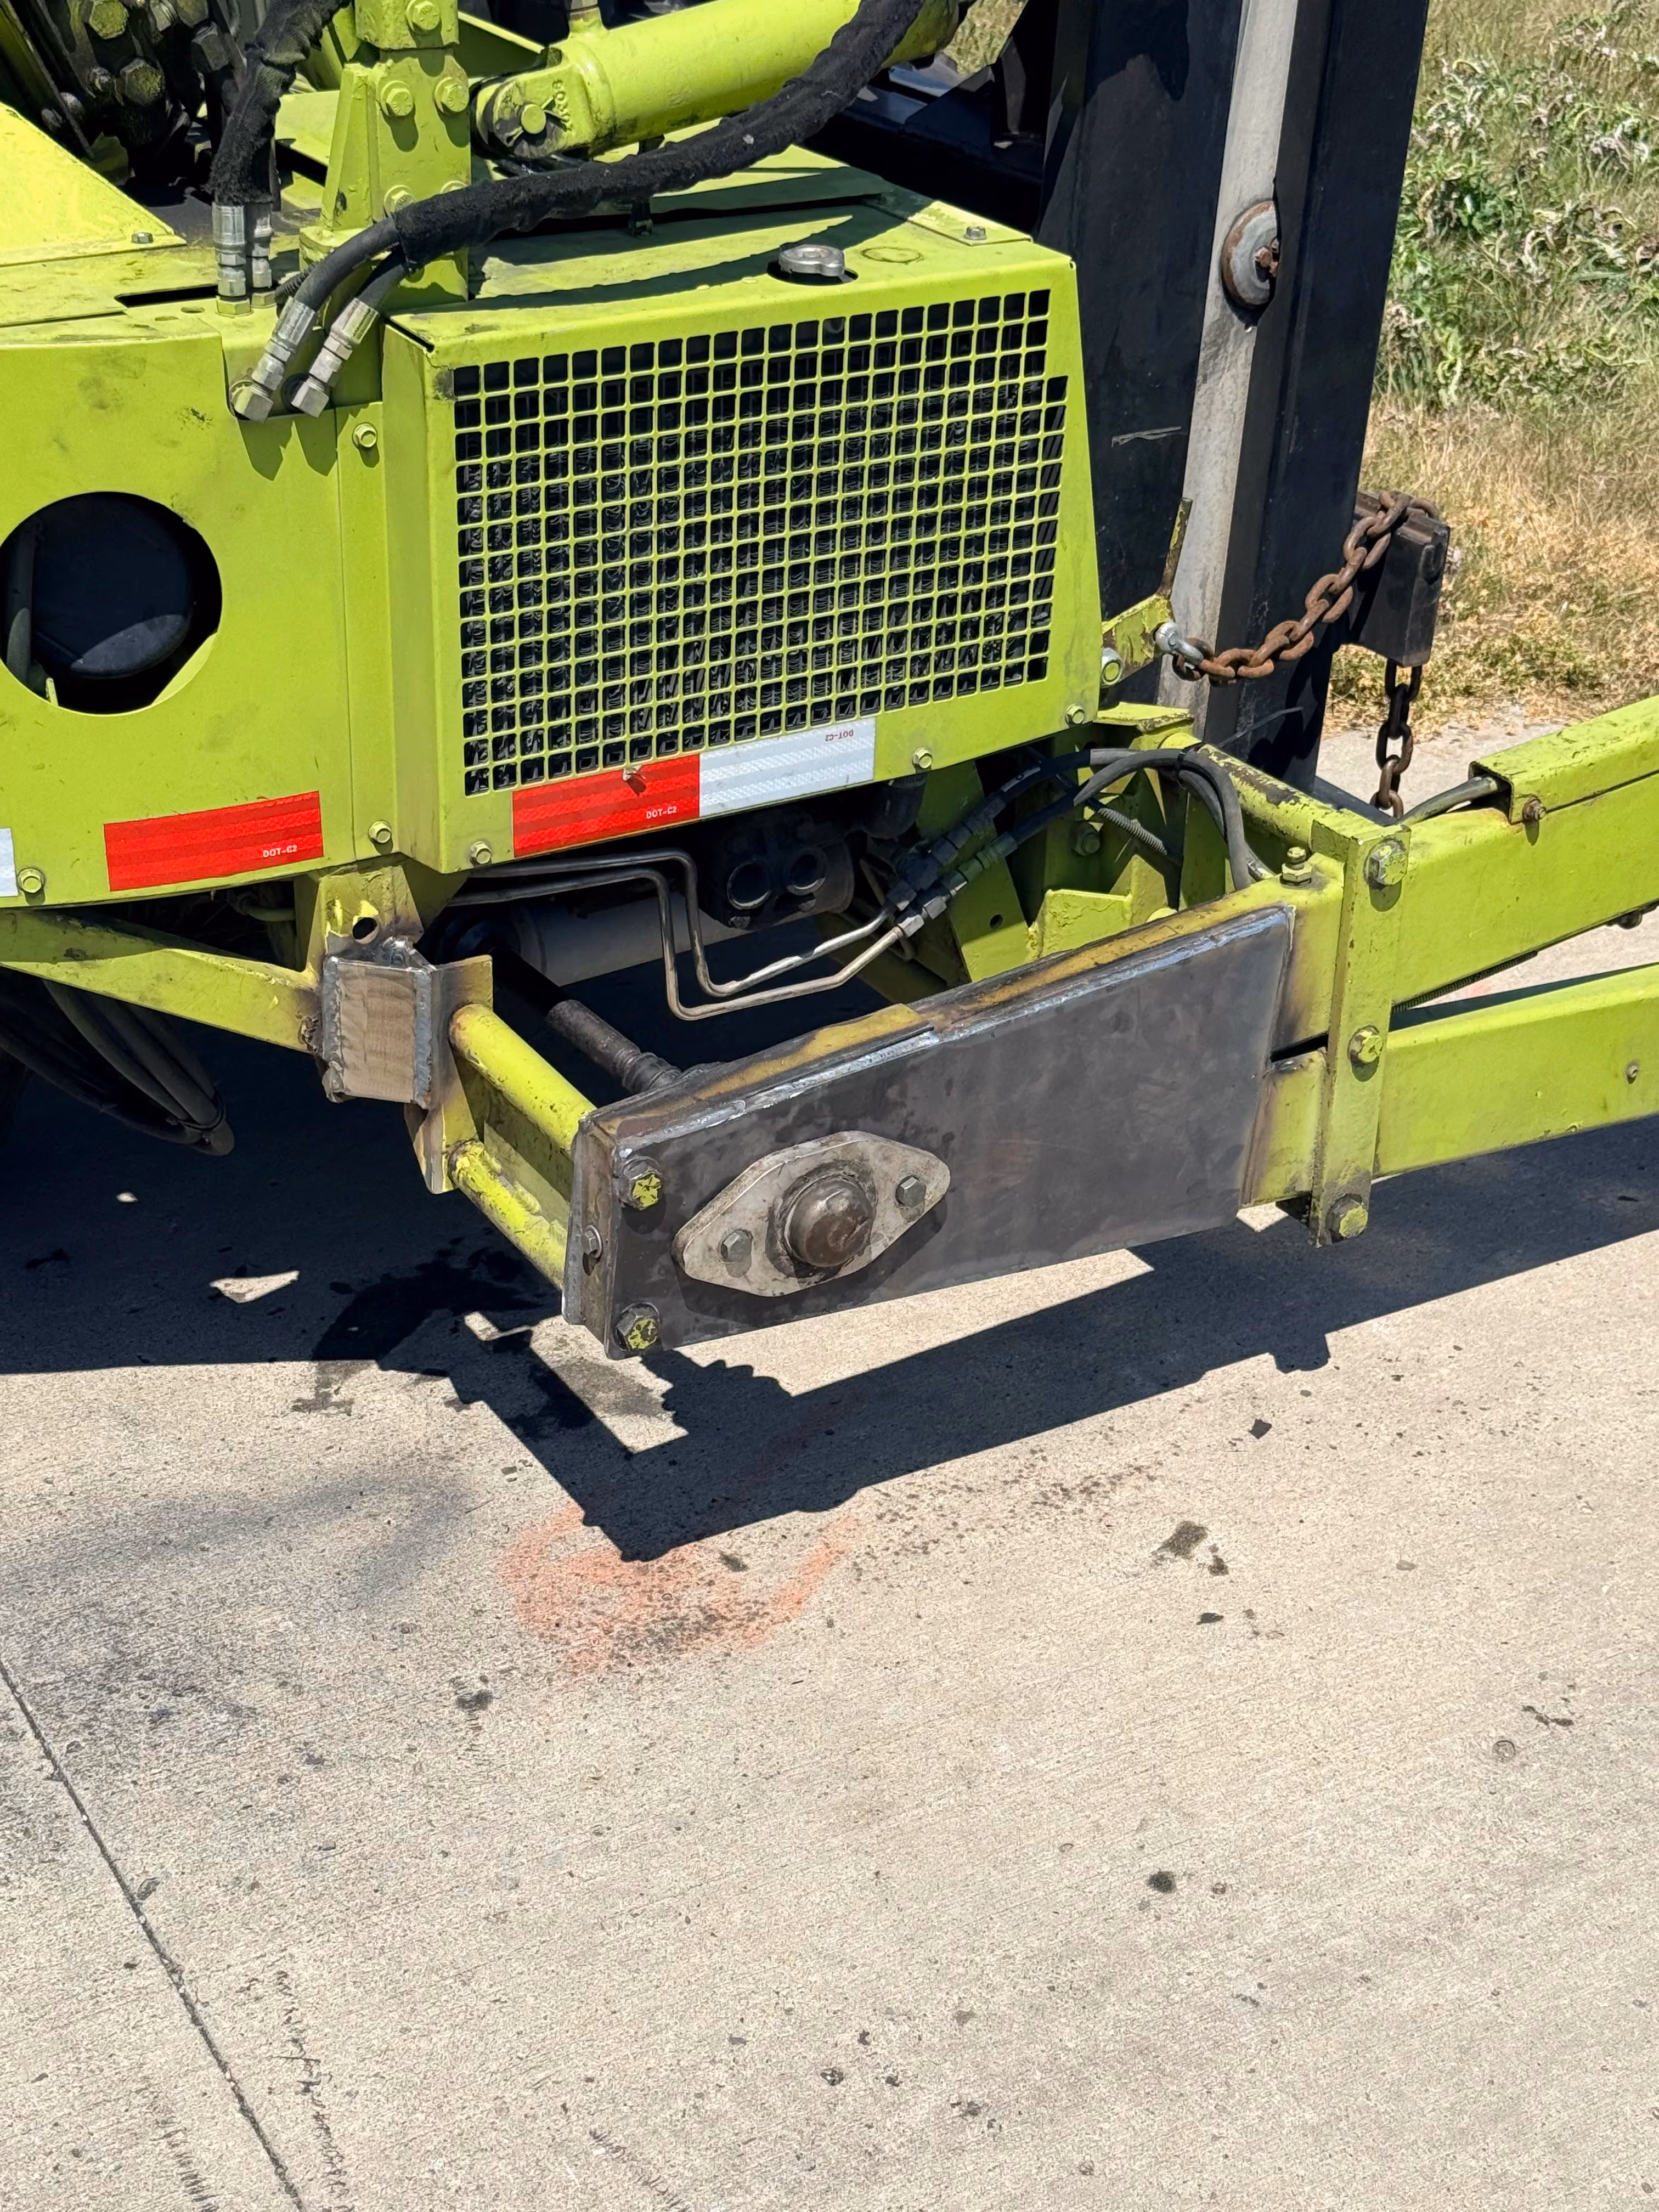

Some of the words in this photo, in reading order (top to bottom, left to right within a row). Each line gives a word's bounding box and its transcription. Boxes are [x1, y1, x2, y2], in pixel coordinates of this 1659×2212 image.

[825, 729, 854, 742] DOT-C2
[646, 805, 677, 819] DOT-C2
[263, 844, 297, 857] DOT-C2
